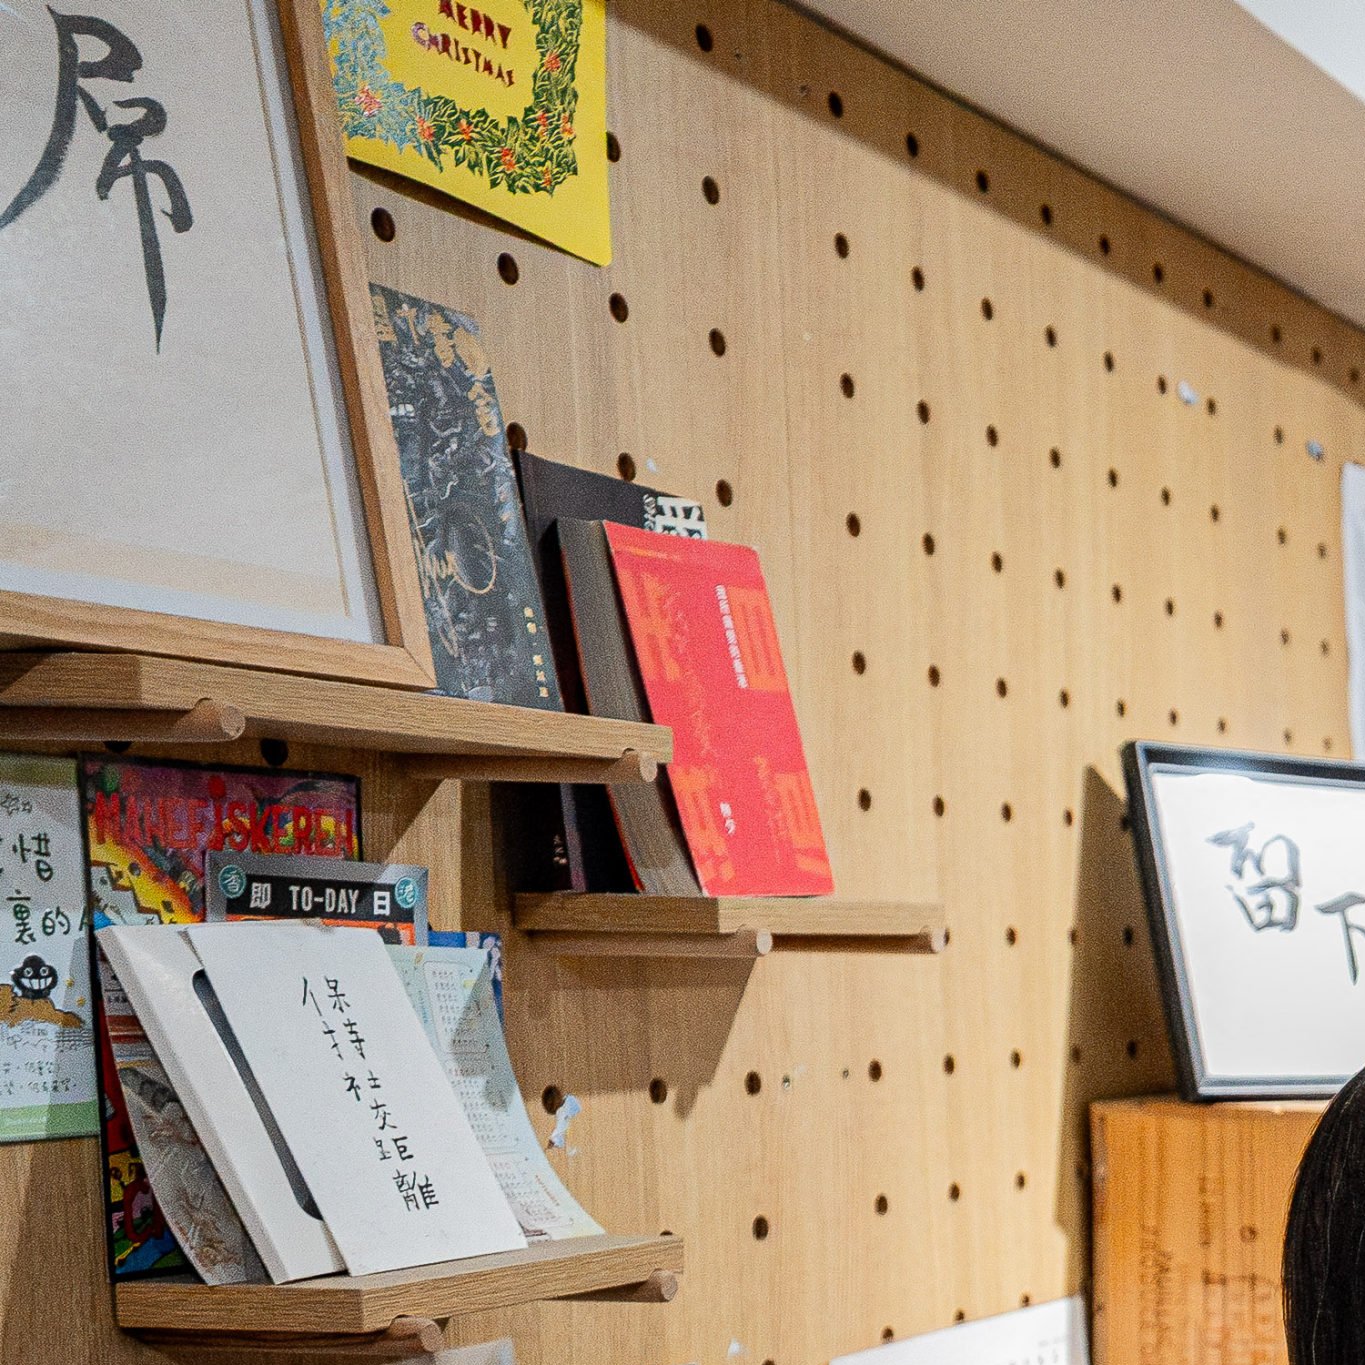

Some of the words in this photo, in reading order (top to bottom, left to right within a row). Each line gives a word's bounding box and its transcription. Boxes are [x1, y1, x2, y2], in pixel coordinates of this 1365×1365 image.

[438, 0, 511, 49] MERRY
[411, 21, 514, 88] CHRISTMAS
[249, 882, 272, 909] 即
[288, 885, 360, 915] TO-DAY
[372, 890, 392, 917] 日
[301, 976, 439, 1212] 保持社交距離
